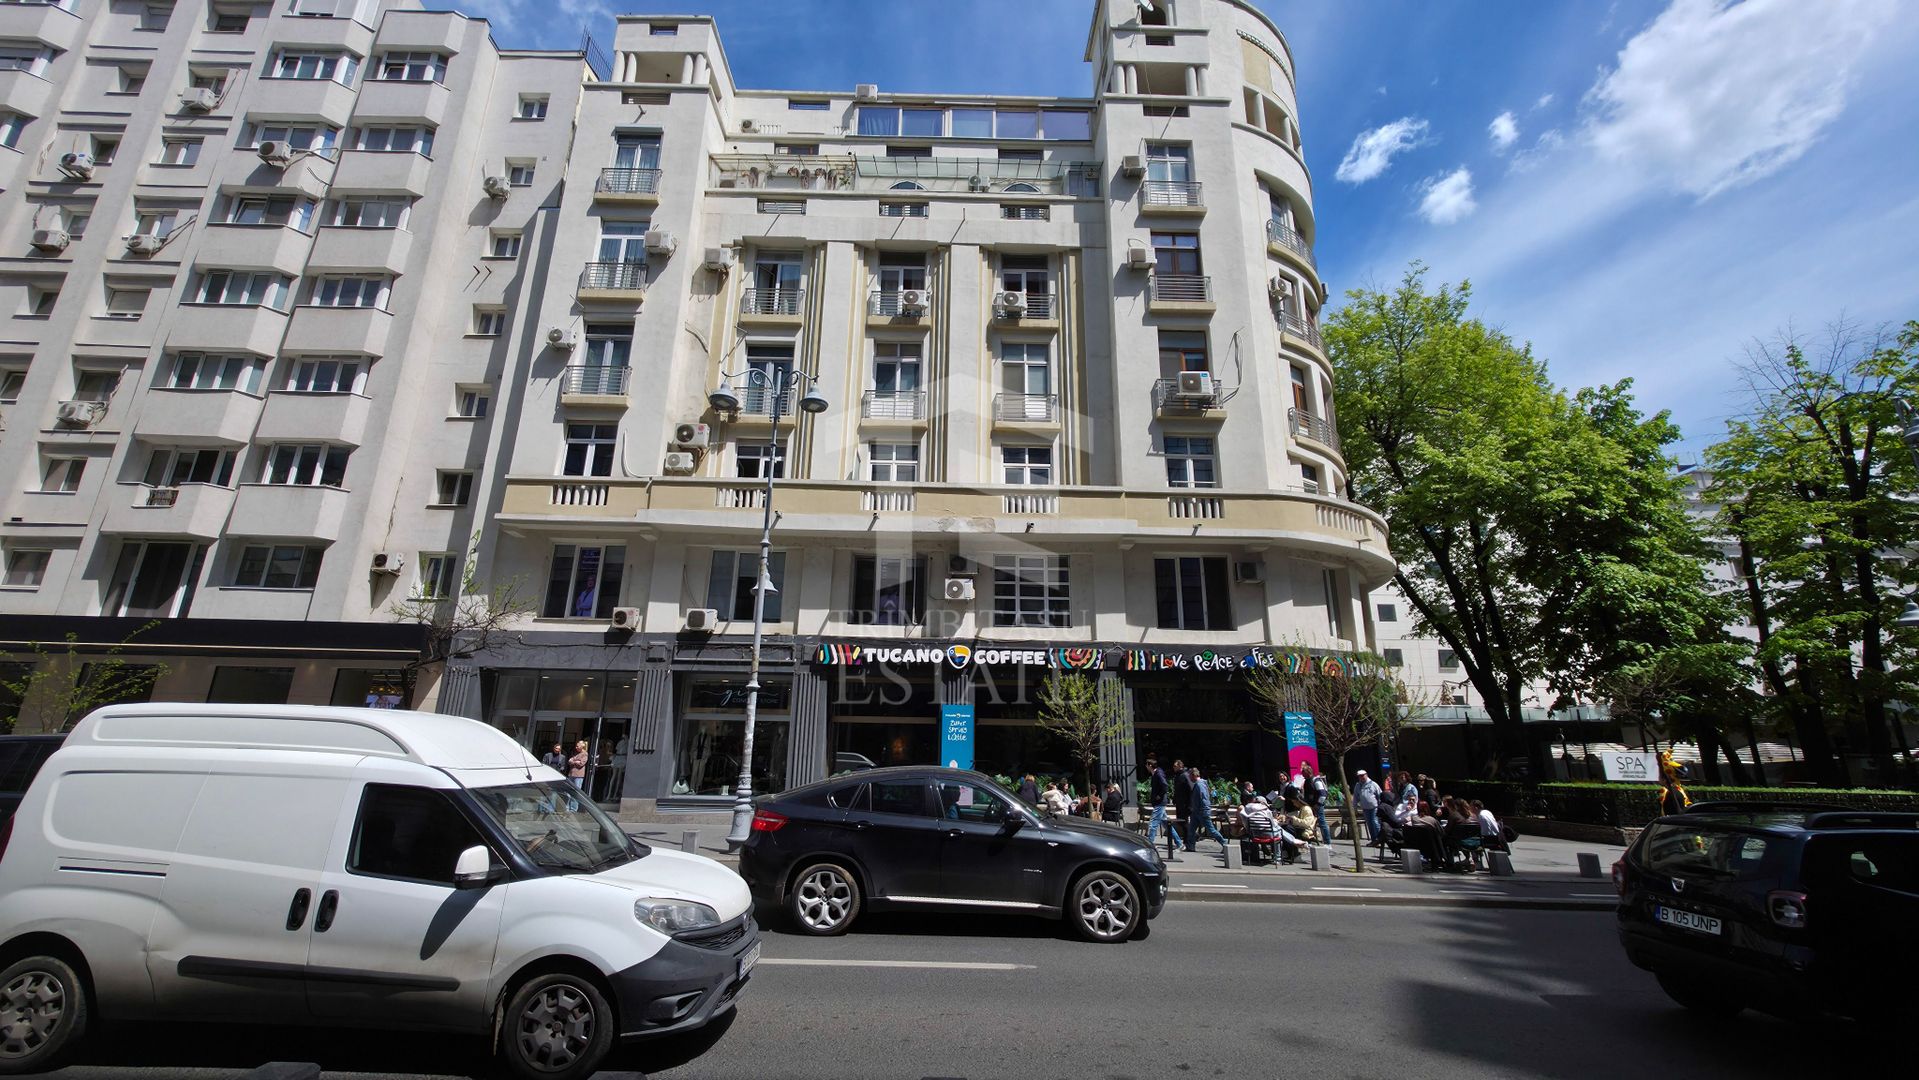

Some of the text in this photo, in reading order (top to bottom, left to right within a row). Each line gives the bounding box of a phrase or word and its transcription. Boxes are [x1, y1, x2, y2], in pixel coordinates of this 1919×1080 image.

[863, 648, 1046, 665] TUCANO COFFEE
[1615, 756, 1646, 770] SPA
[1661, 908, 1718, 931] B 105 UNP
